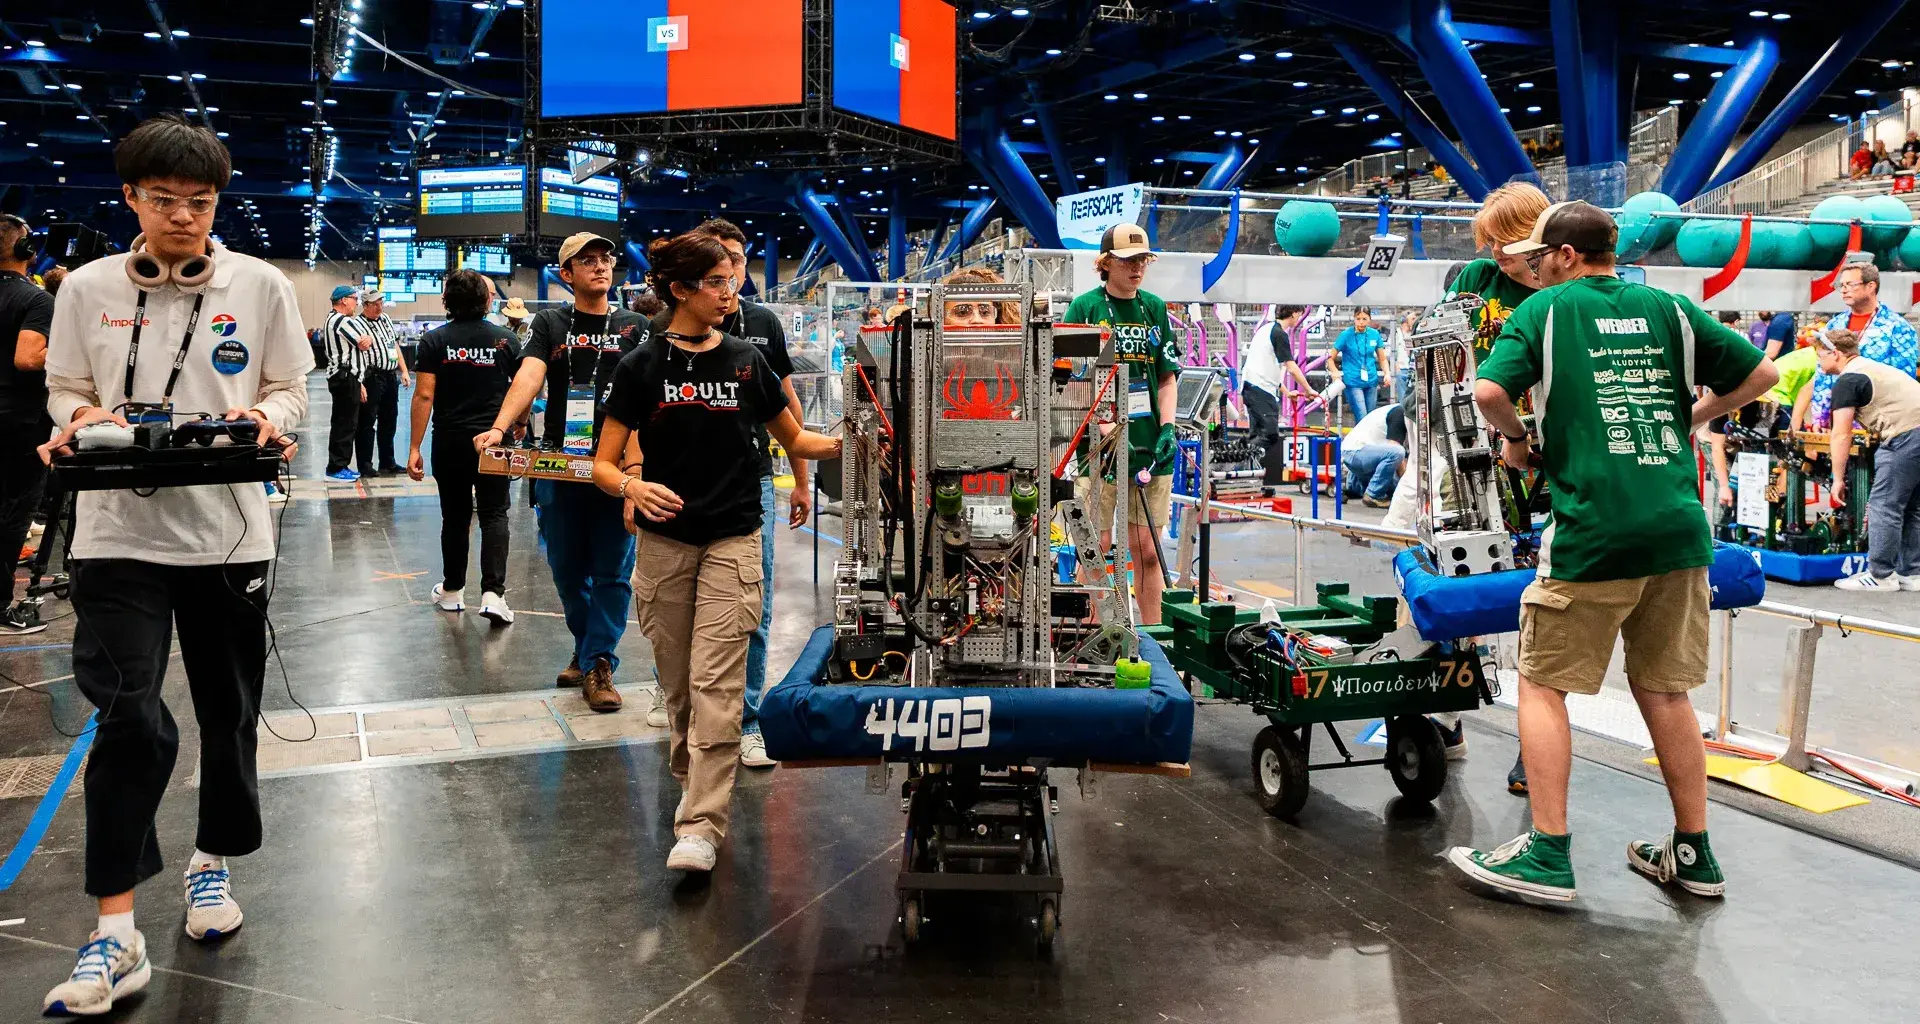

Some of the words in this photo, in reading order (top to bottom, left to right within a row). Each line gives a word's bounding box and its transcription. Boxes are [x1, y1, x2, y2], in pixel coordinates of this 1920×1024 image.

[661, 29, 674, 38] VS
[1071, 192, 1123, 220] REEFSCAPE
[100, 312, 150, 329] Ampe
[1595, 318, 1649, 334] WEBBER
[744, 336, 769, 345] 03
[446, 345, 497, 361] ROULT
[664, 380, 739, 402] ROULT
[710, 399, 738, 407] 4403
[535, 458, 567, 468] CTR
[1841, 556, 1870, 576] 47
[1440, 660, 1474, 688] 76
[864, 696, 992, 752] 4403
